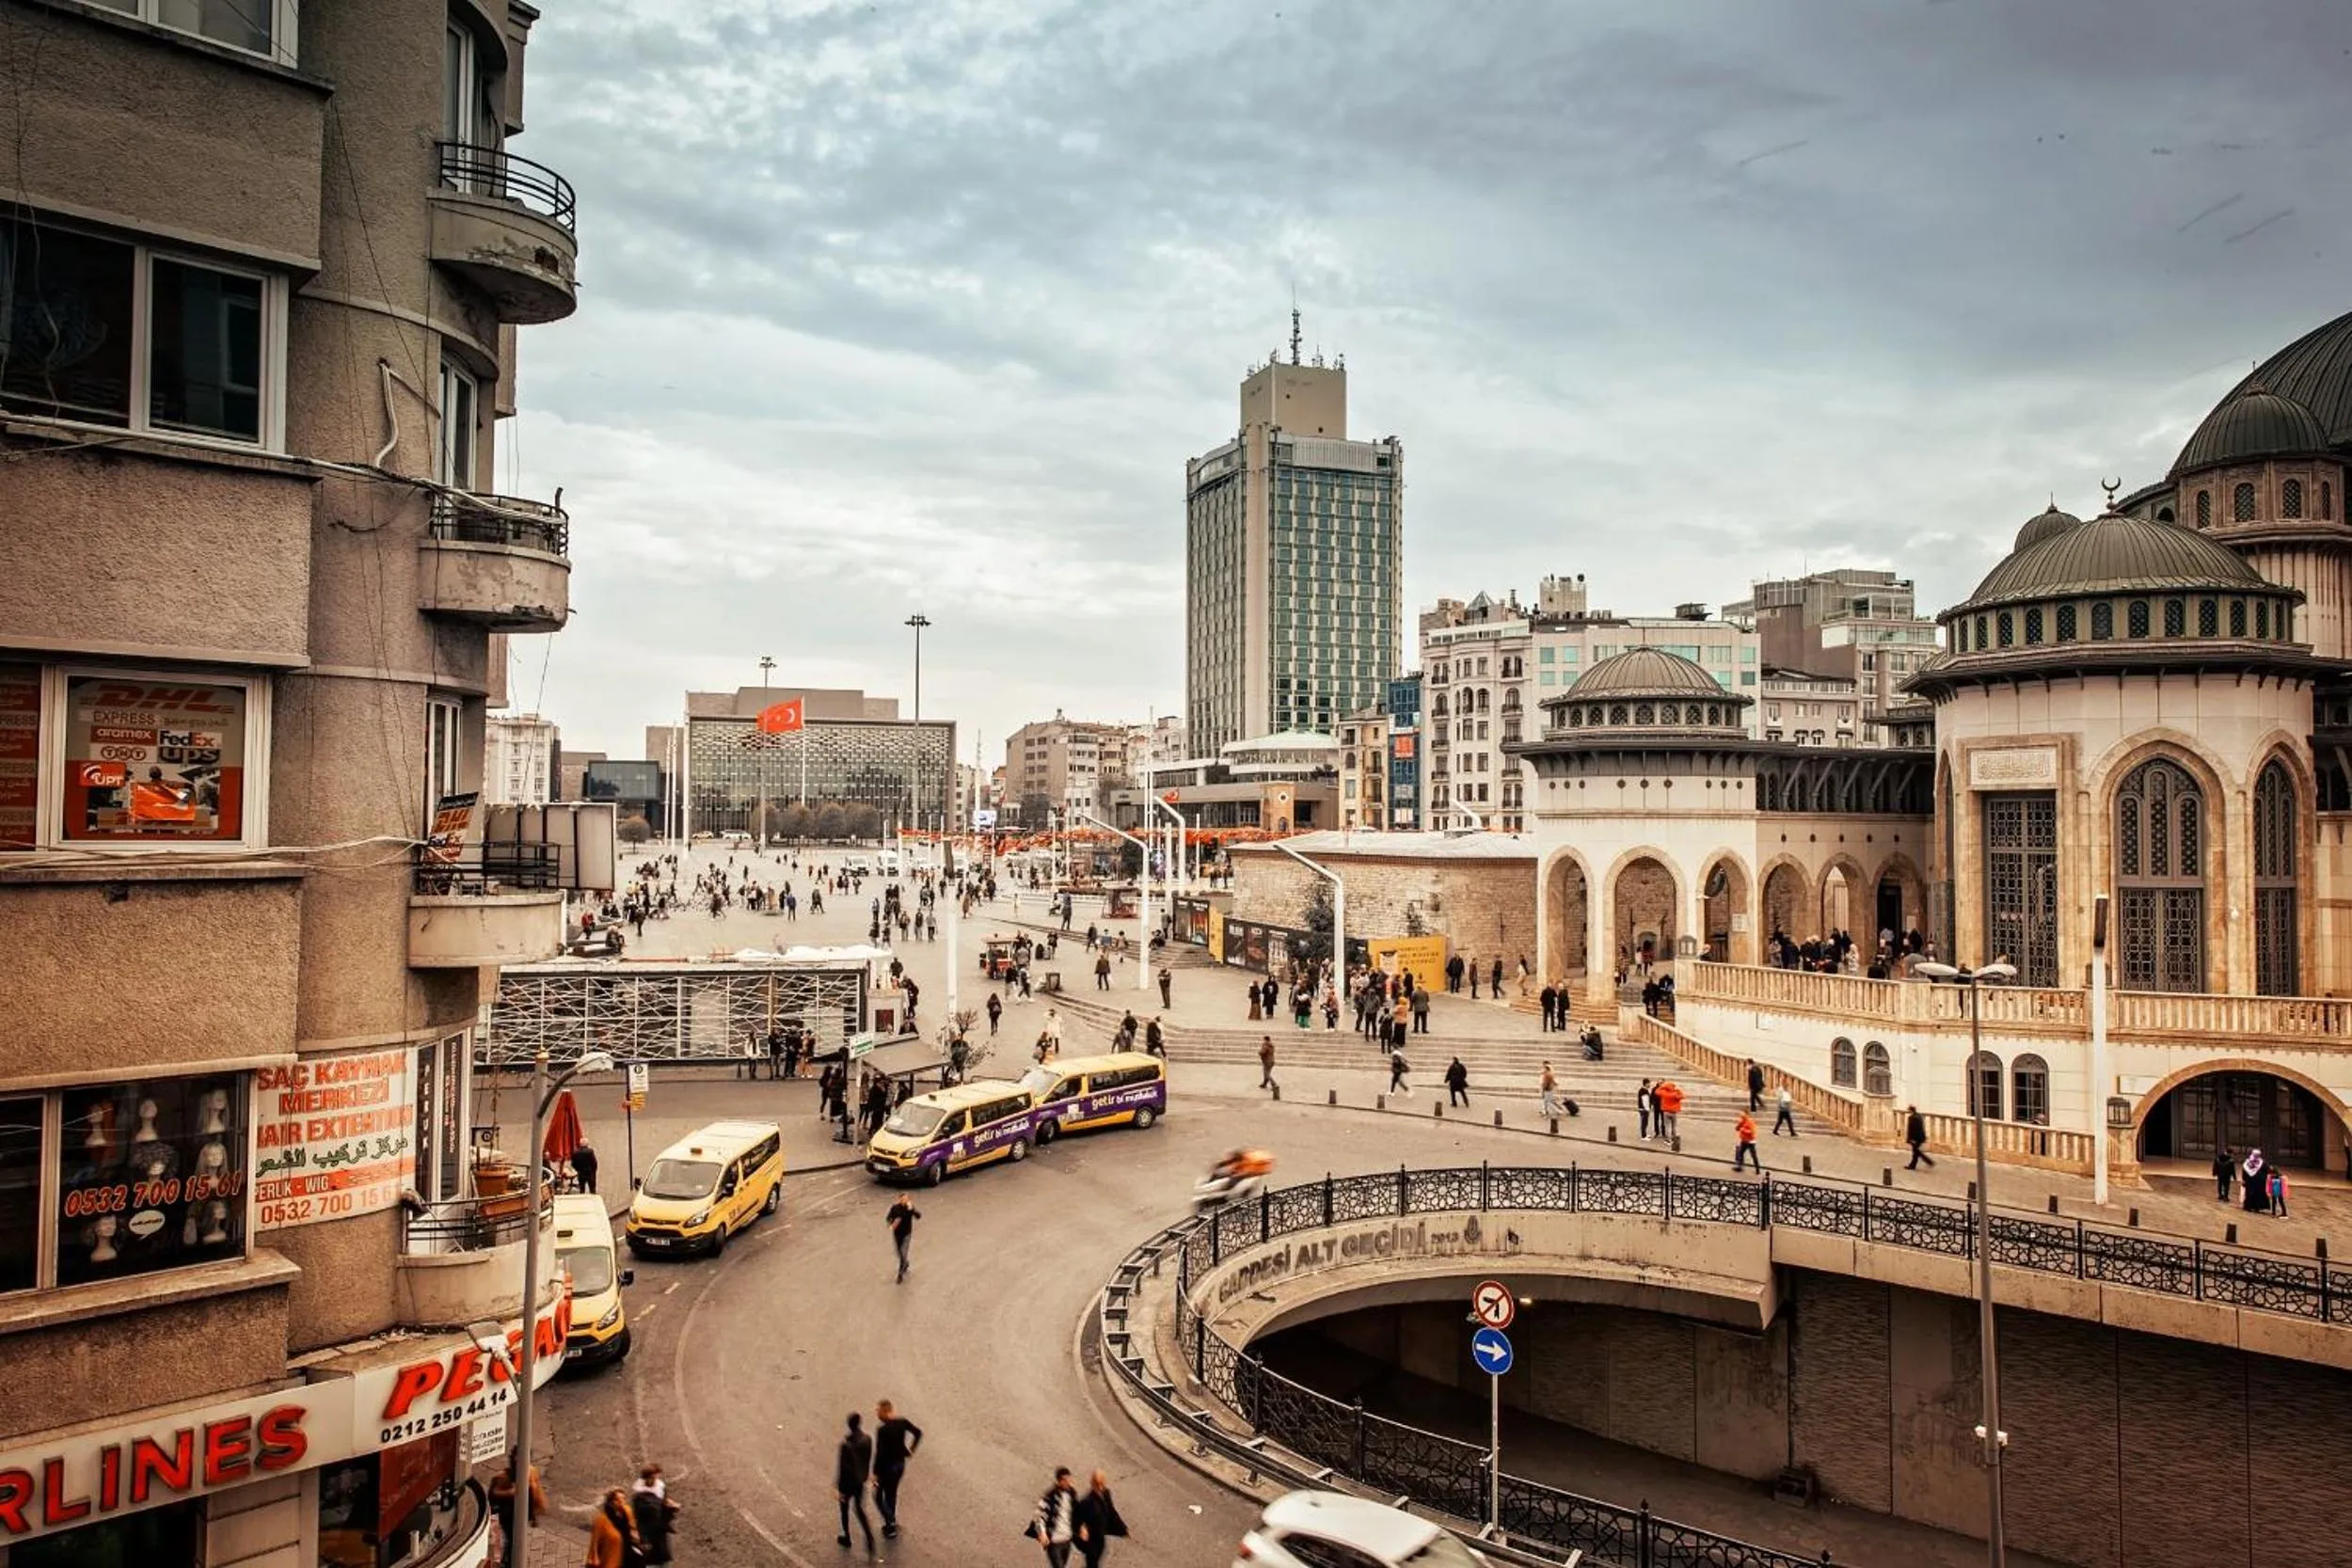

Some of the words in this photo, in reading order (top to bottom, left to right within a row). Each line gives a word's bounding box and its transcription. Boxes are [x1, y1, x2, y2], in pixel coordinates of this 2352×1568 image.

[94, 685, 221, 712] DHL
[93, 710, 157, 725] EXPRESS
[97, 727, 152, 740] aramex
[159, 730, 215, 747] FedEx
[101, 745, 147, 761] TNT
[159, 747, 221, 764] ups
[93, 773, 124, 786] UPT
[257, 1065, 310, 1092] SAÇ
[314, 1053, 406, 1085] KAYNAK
[1091, 1095, 1116, 1111] getir
[311, 1140, 368, 1168] تركيب
[371, 1135, 408, 1160] مركز
[65, 1185, 128, 1217] 0532
[133, 1179, 181, 1208] 700
[184, 1174, 212, 1202] 15
[216, 1171, 243, 1196] 61
[305, 1174, 329, 1193] WIG
[262, 1200, 311, 1224] 0532
[319, 1194, 353, 1215] 700
[360, 1188, 380, 1209] 15
[1295, 1237, 1337, 1271] ALT
[1341, 1222, 1425, 1259] GEÇİDİ
[381, 1418, 425, 1443] 0212
[432, 1407, 462, 1428] 250
[468, 1397, 485, 1415] 44
[491, 1388, 508, 1405] 14
[0, 1403, 308, 1534] RLINES
